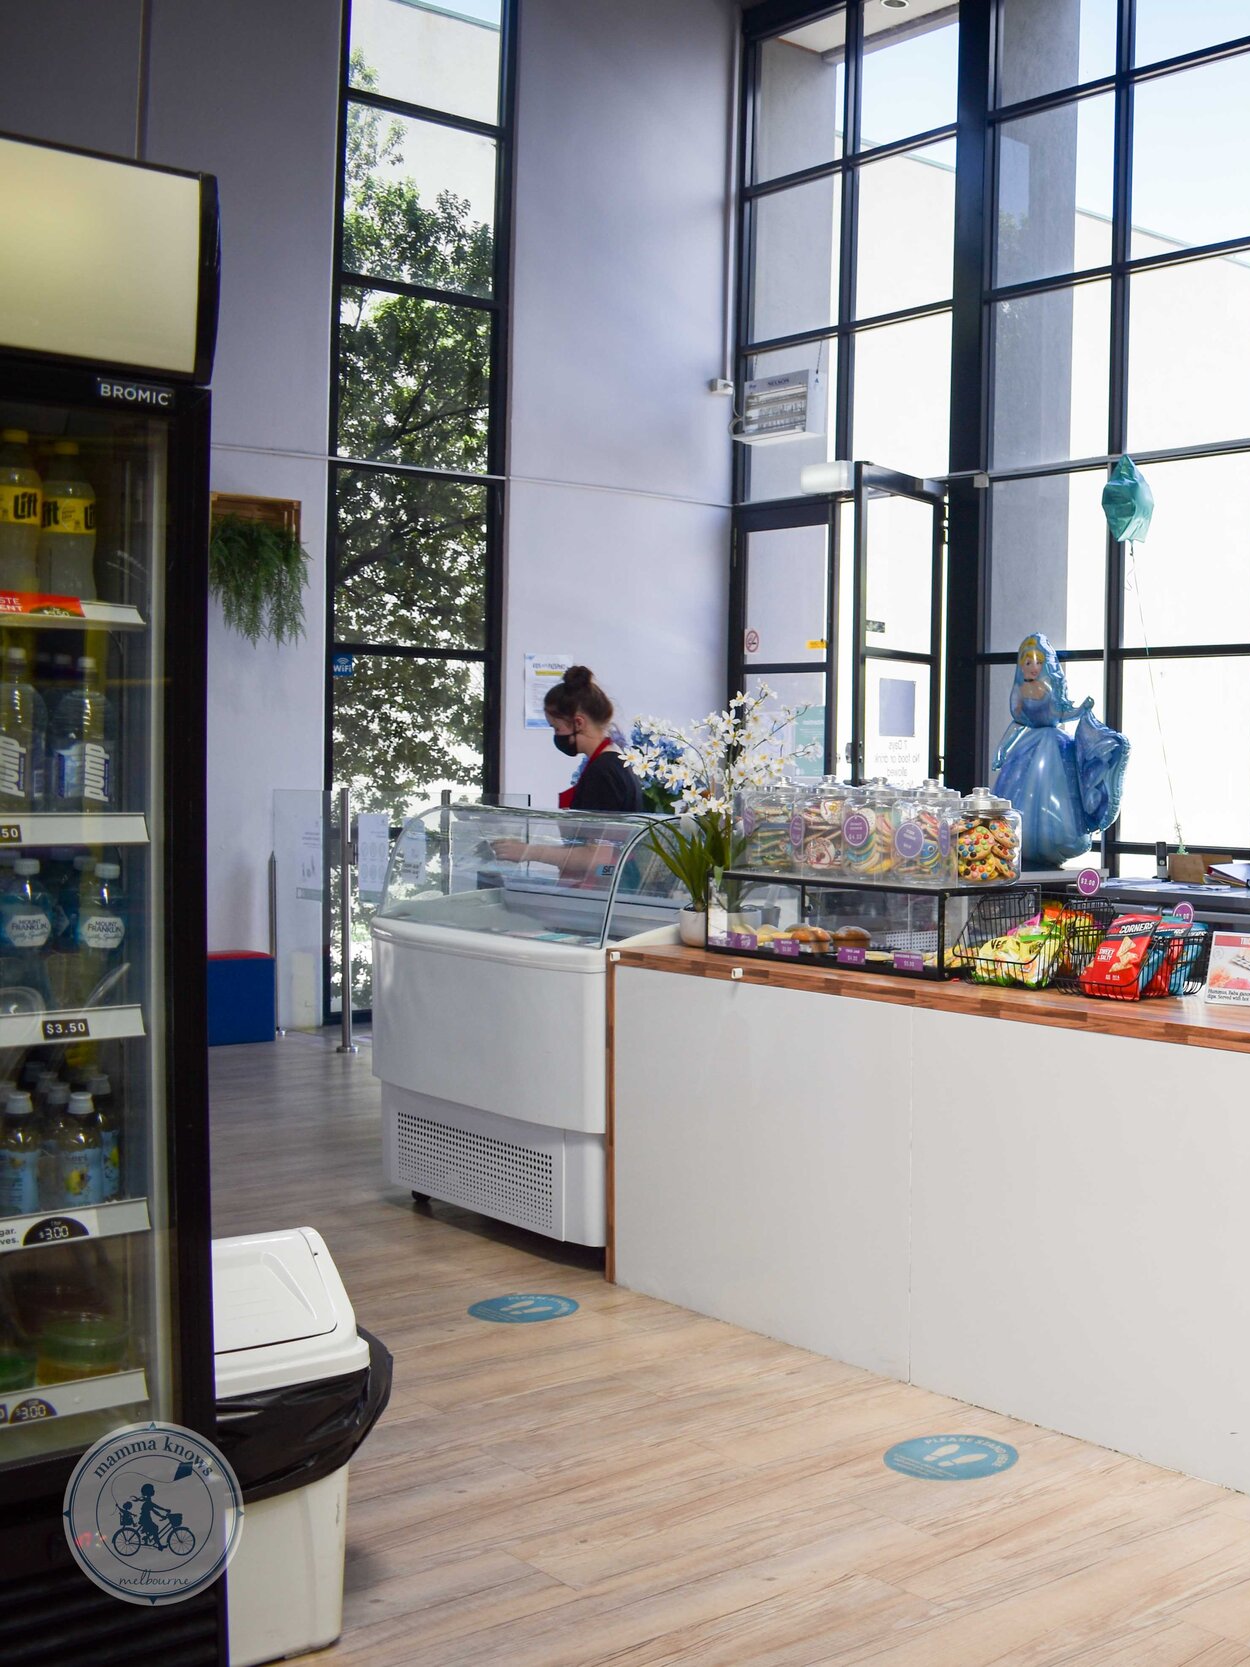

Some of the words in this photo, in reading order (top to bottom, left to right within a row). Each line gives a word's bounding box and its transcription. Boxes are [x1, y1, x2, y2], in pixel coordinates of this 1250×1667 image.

[100, 383, 169, 406] BROMIC
[13, 492, 38, 520] Lift
[333, 664, 352, 673] WiFi
[84, 742, 110, 802] pump
[11, 923, 48, 931] FRANKLIN
[88, 924, 122, 932] FRANKLIN
[1120, 922, 1154, 934] CORNERS
[46, 1022, 86, 1034] $3.50
[39, 1226, 69, 1240] $3.00
[16, 1404, 46, 1420] $3.00
